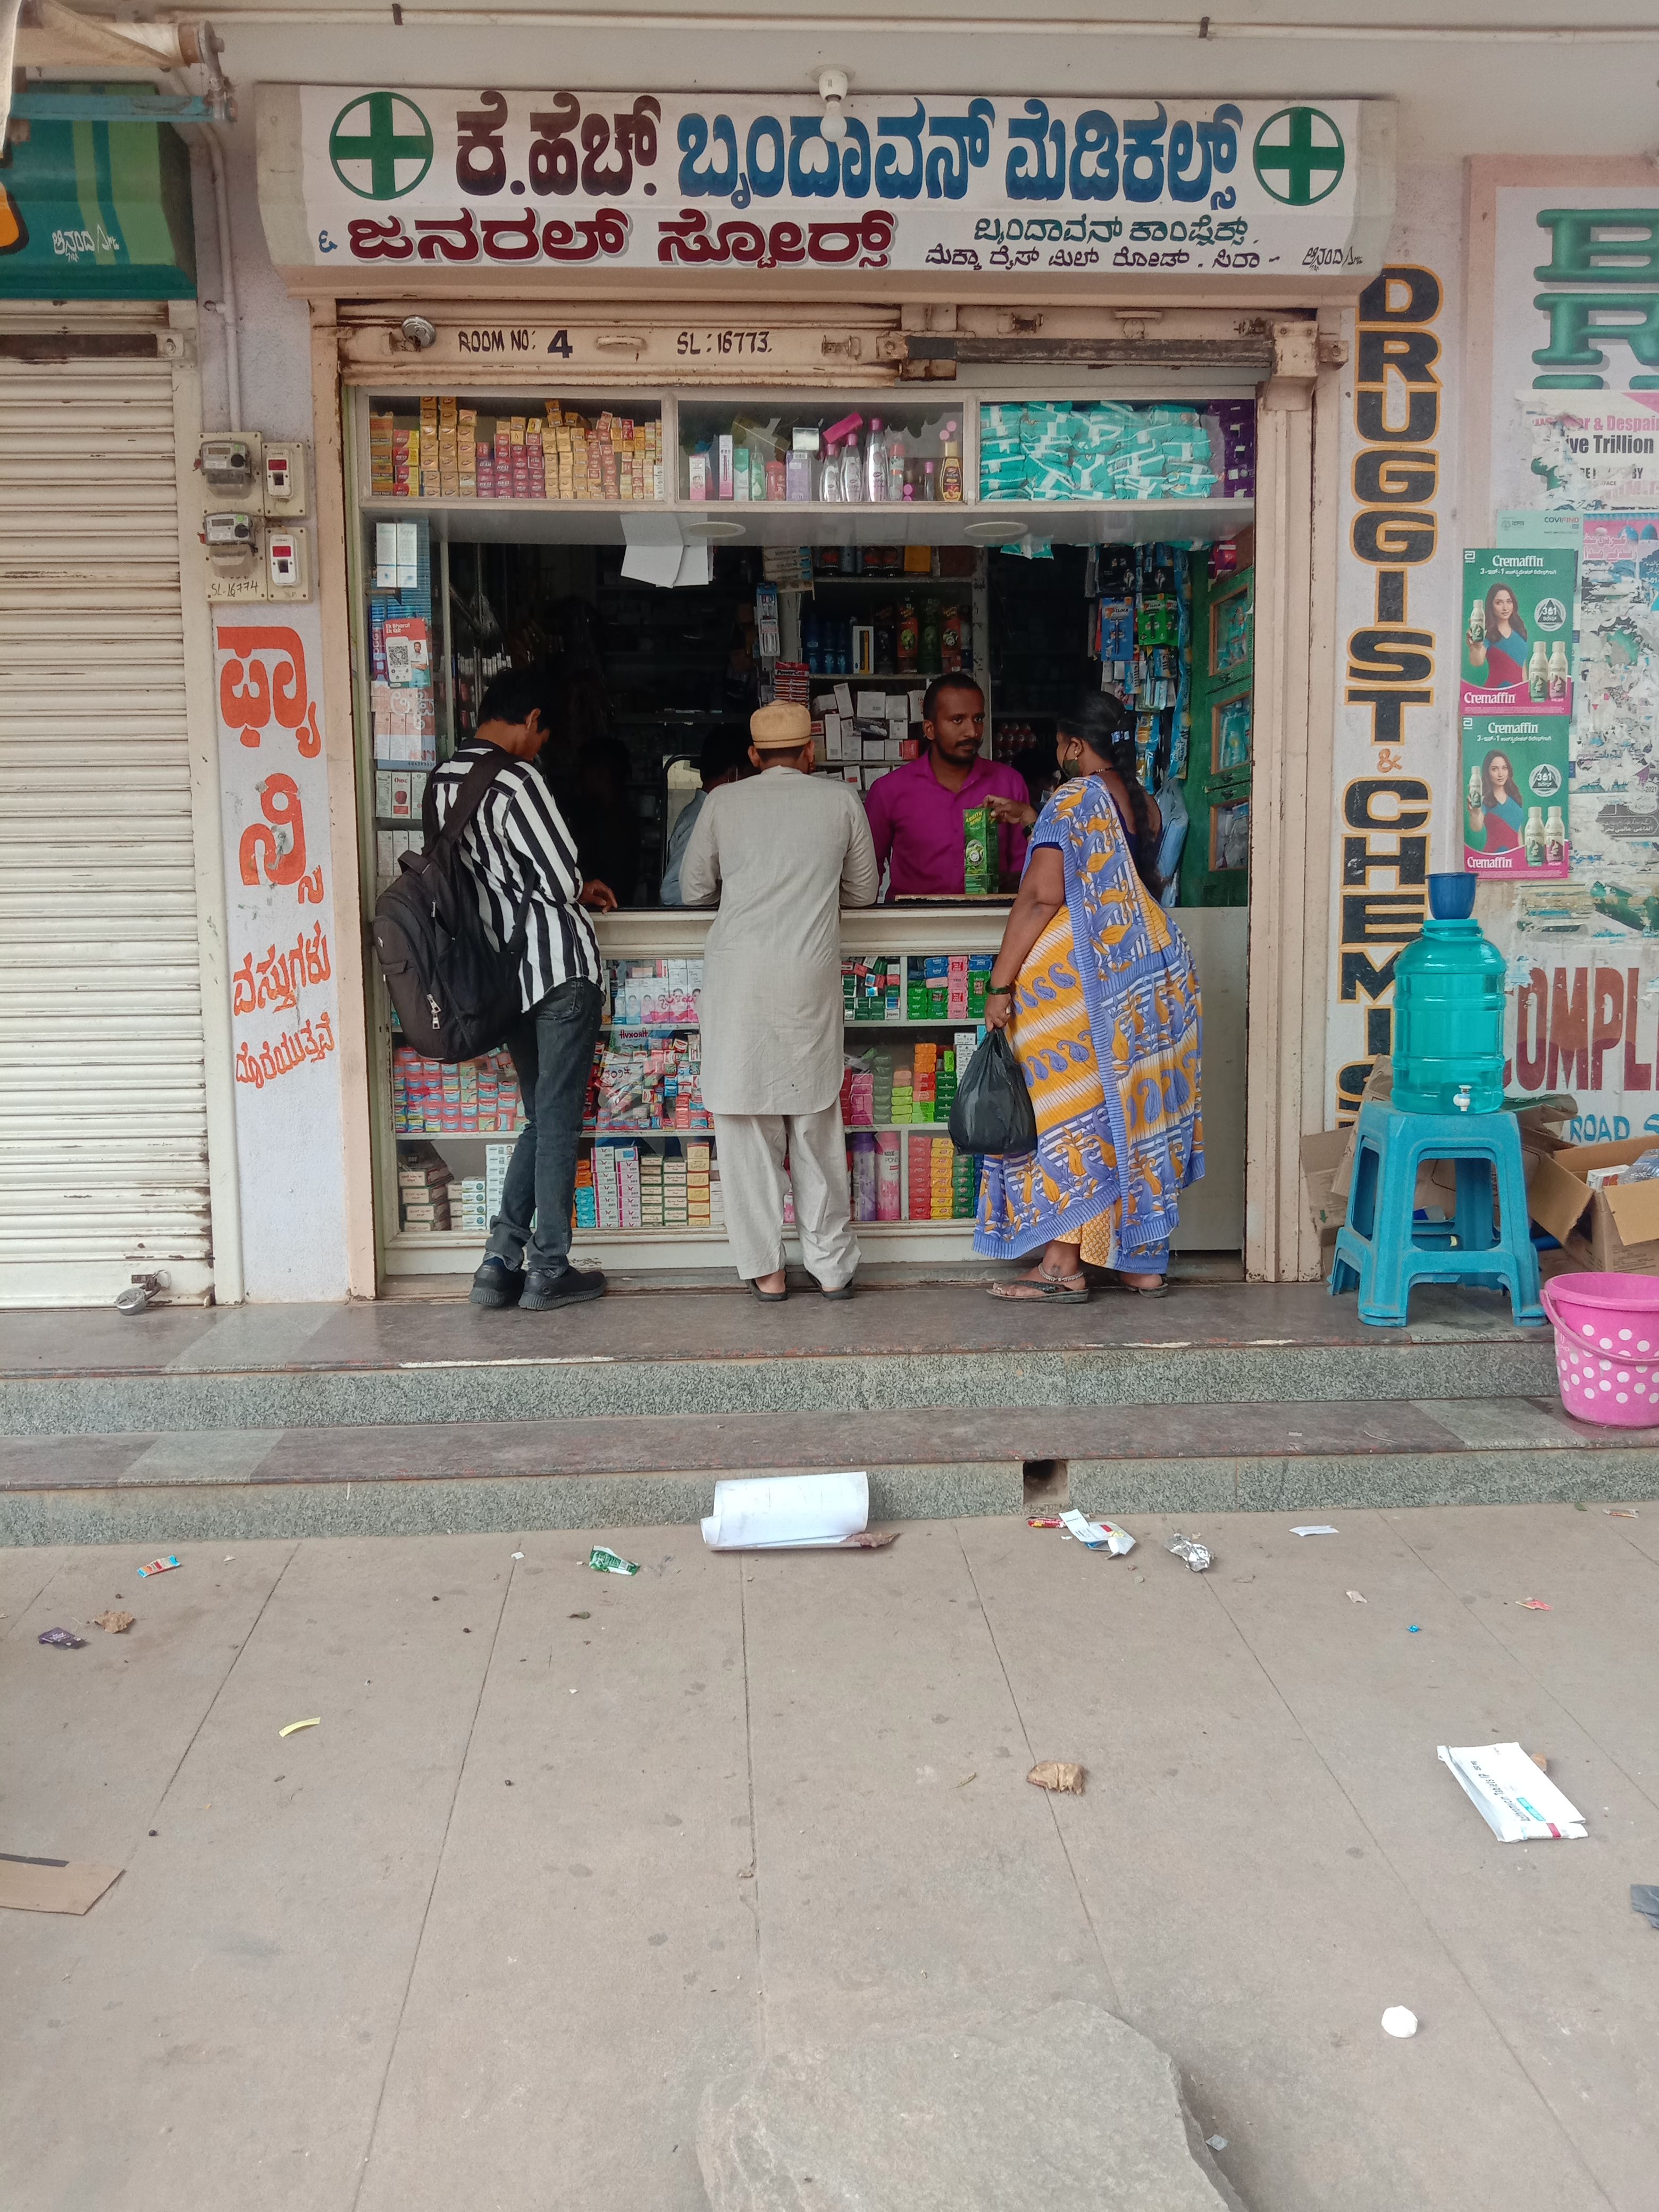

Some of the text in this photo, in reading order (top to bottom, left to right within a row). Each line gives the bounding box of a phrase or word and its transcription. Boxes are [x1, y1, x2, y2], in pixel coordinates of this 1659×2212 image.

[677, 98, 995, 208] ಬೃಂದಾವನ್
[1006, 98, 1243, 210] ಮೆಡಿಕಲ್ಸ್
[348, 208, 630, 263] ಜನರಲ್
[658, 208, 894, 268] ಸ್ಟೋರ್ಸ್
[458, 328, 505, 353] ROOM
[548, 329, 573, 358] 4
[1593, 435, 1654, 453] Trillion
[1349, 263, 1443, 747] DRUGGIST
[1492, 555, 1544, 567] Cremaffin
[1464, 692, 1515, 703] Cremaffin
[1488, 723, 1538, 734] Cremaffin
[1377, 749, 1402, 773] &
[1467, 857, 1513, 868] Cremaffin
[233, 919, 331, 1016] ವಸ್ತುಗಳು
[1504, 966, 1659, 1093] OMPL
[1570, 1114, 1630, 1142] ROAD
[1485, 1778, 1504, 1796] Tablets
